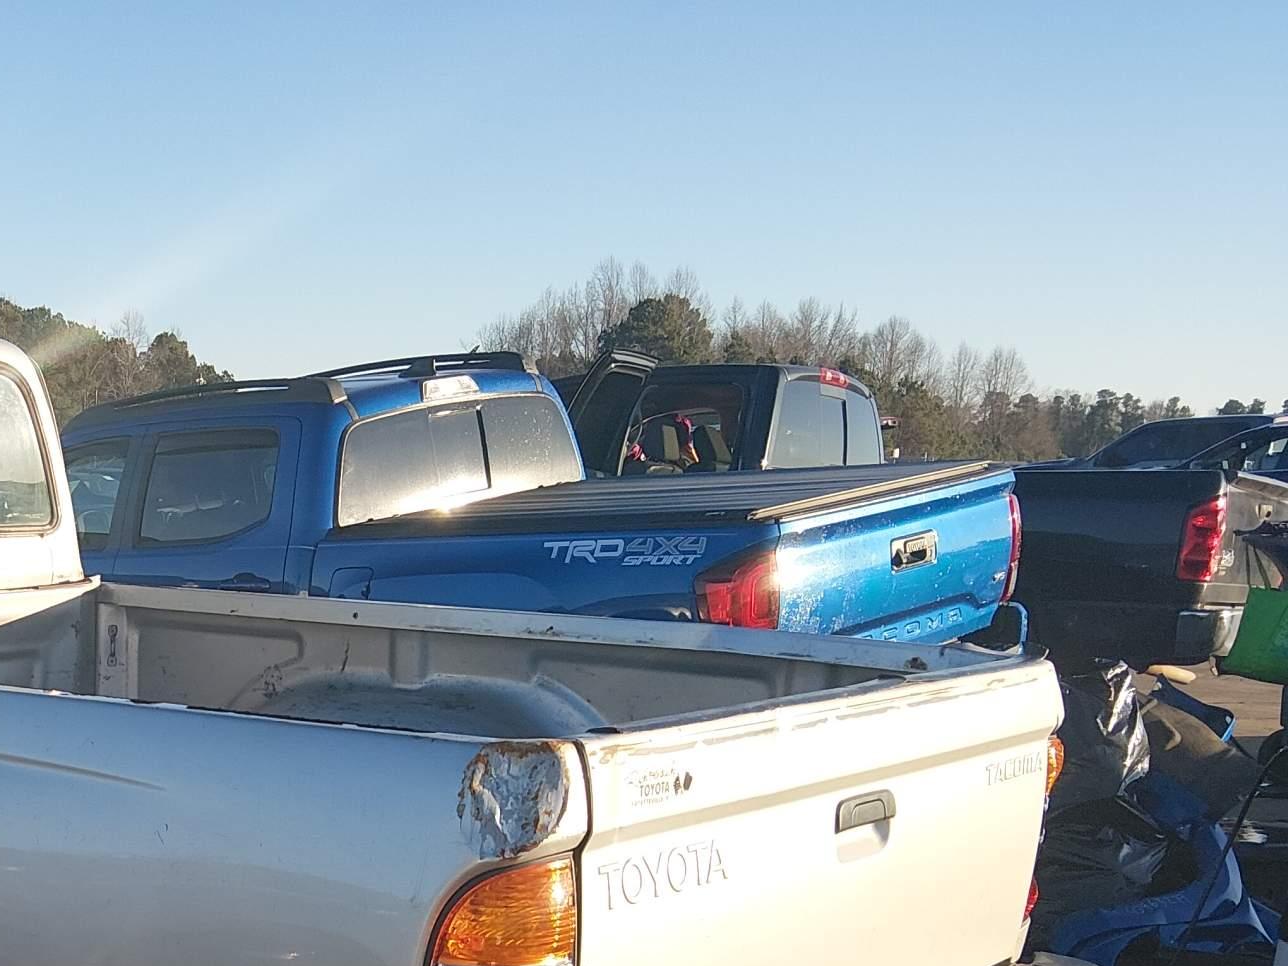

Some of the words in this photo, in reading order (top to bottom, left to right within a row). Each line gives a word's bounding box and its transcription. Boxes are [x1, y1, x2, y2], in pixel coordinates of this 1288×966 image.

[544, 539, 624, 563] TRD
[625, 537, 707, 554] 4X4
[622, 555, 702, 566] SPORT
[985, 752, 1043, 786] TACOMA
[640, 781, 670, 797] TOYOTA
[598, 840, 728, 910] TOYOTA
